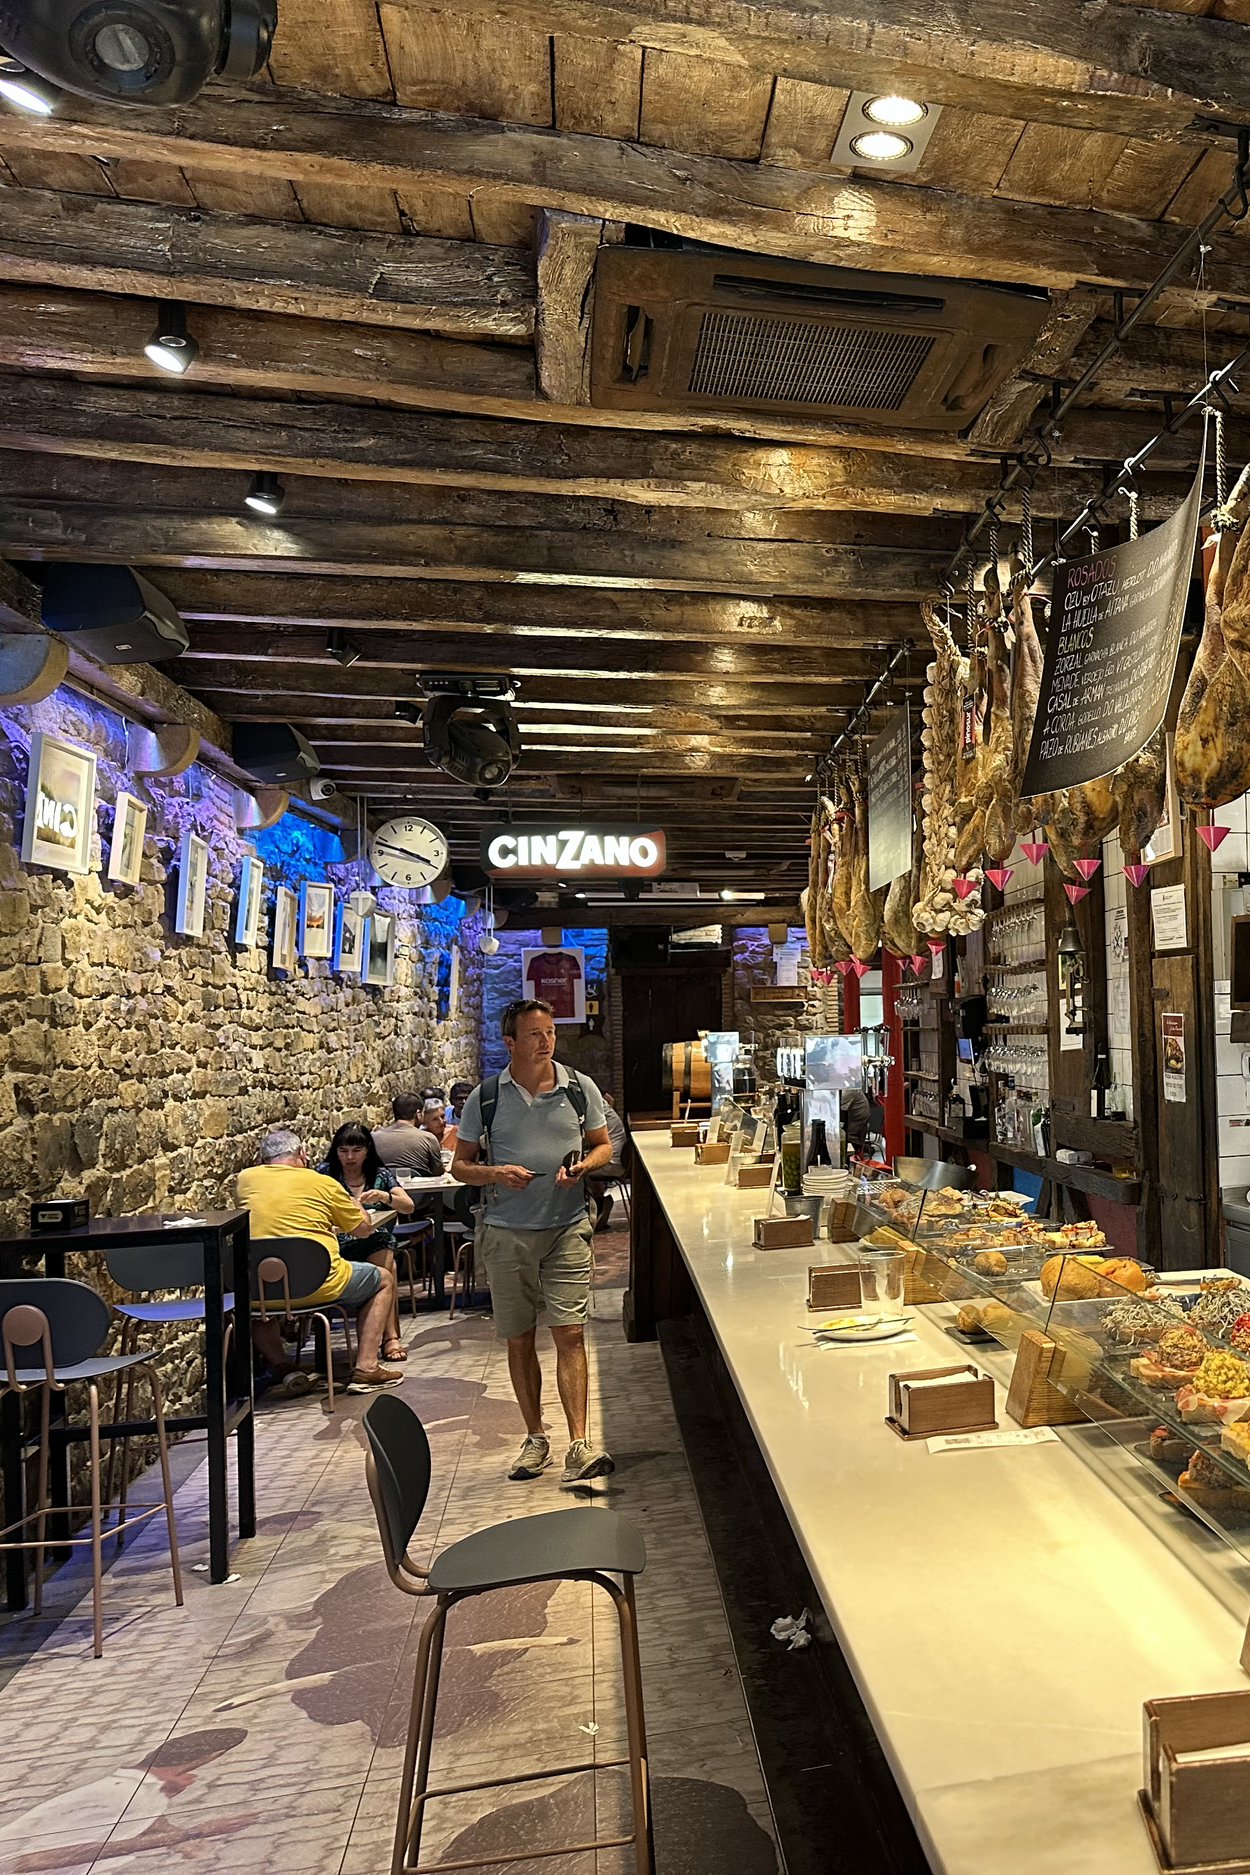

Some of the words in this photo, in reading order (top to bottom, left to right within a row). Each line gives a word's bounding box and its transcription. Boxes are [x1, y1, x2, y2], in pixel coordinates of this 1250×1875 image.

[1067, 554, 1117, 588] ROSADOS
[1061, 614, 1072, 634] LA
[1072, 606, 1098, 629] HUELLA
[1057, 626, 1095, 656] BLANCOS
[1047, 691, 1072, 714] CASAL
[1039, 736, 1059, 760] PAZO
[488, 830, 658, 870] CINZANO
